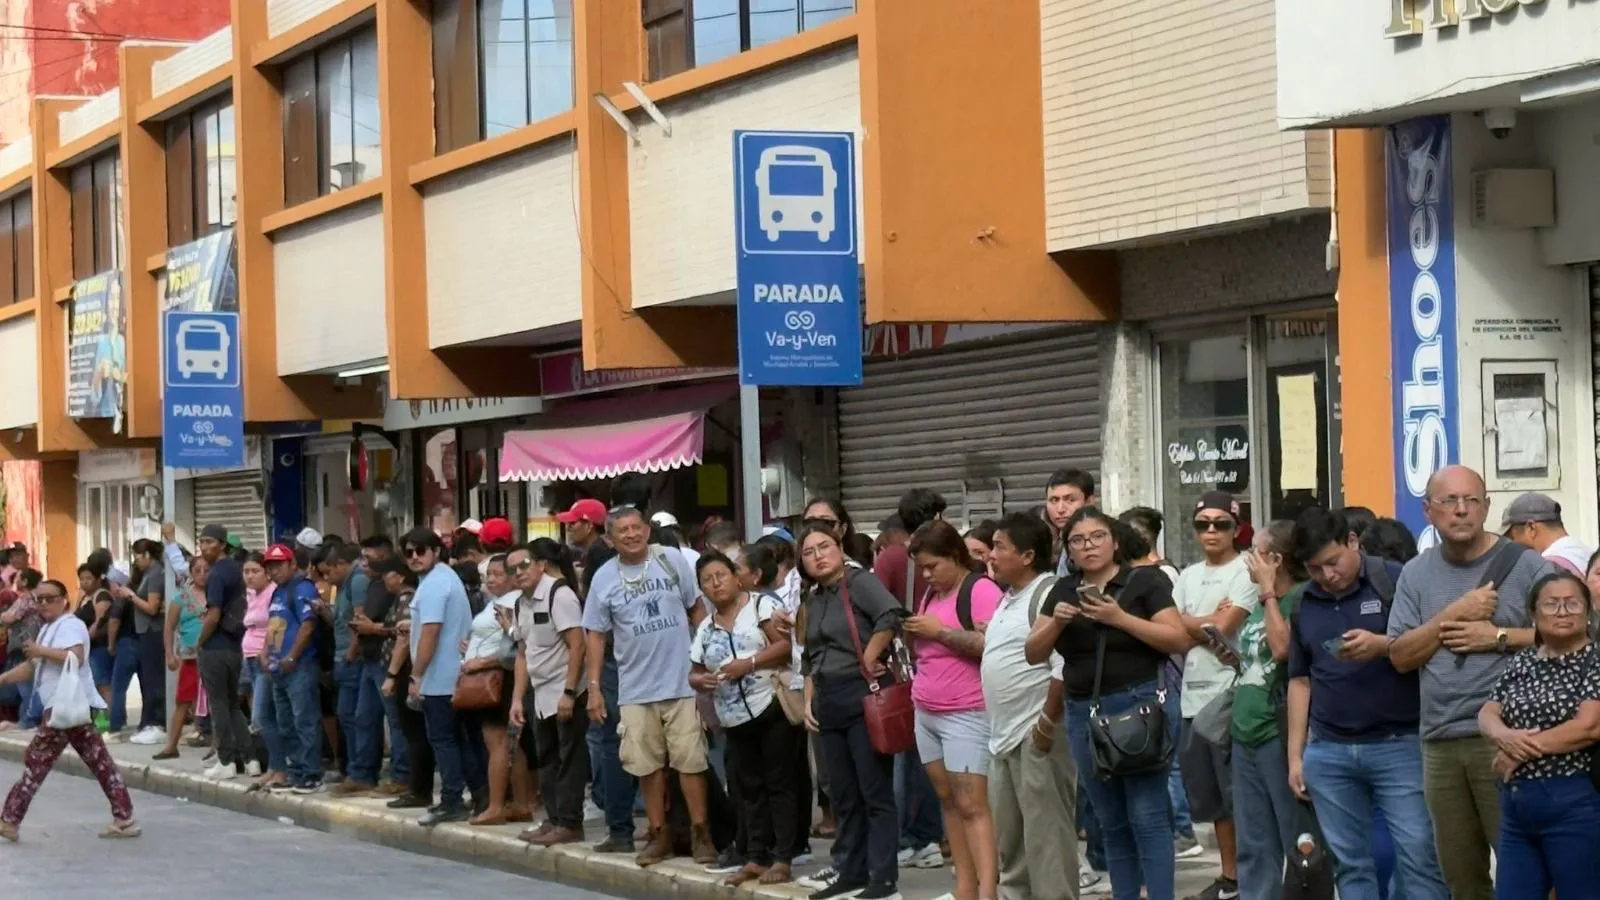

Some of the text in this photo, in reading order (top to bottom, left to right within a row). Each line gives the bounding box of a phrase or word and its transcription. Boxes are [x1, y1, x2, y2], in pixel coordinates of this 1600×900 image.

[753, 284, 844, 303] PARADA
[1403, 147, 1447, 498] Shoes
[765, 331, 837, 350] Va-y-Ven
[173, 404, 233, 417] PARADA
[632, 615, 679, 637] BASEBALL
